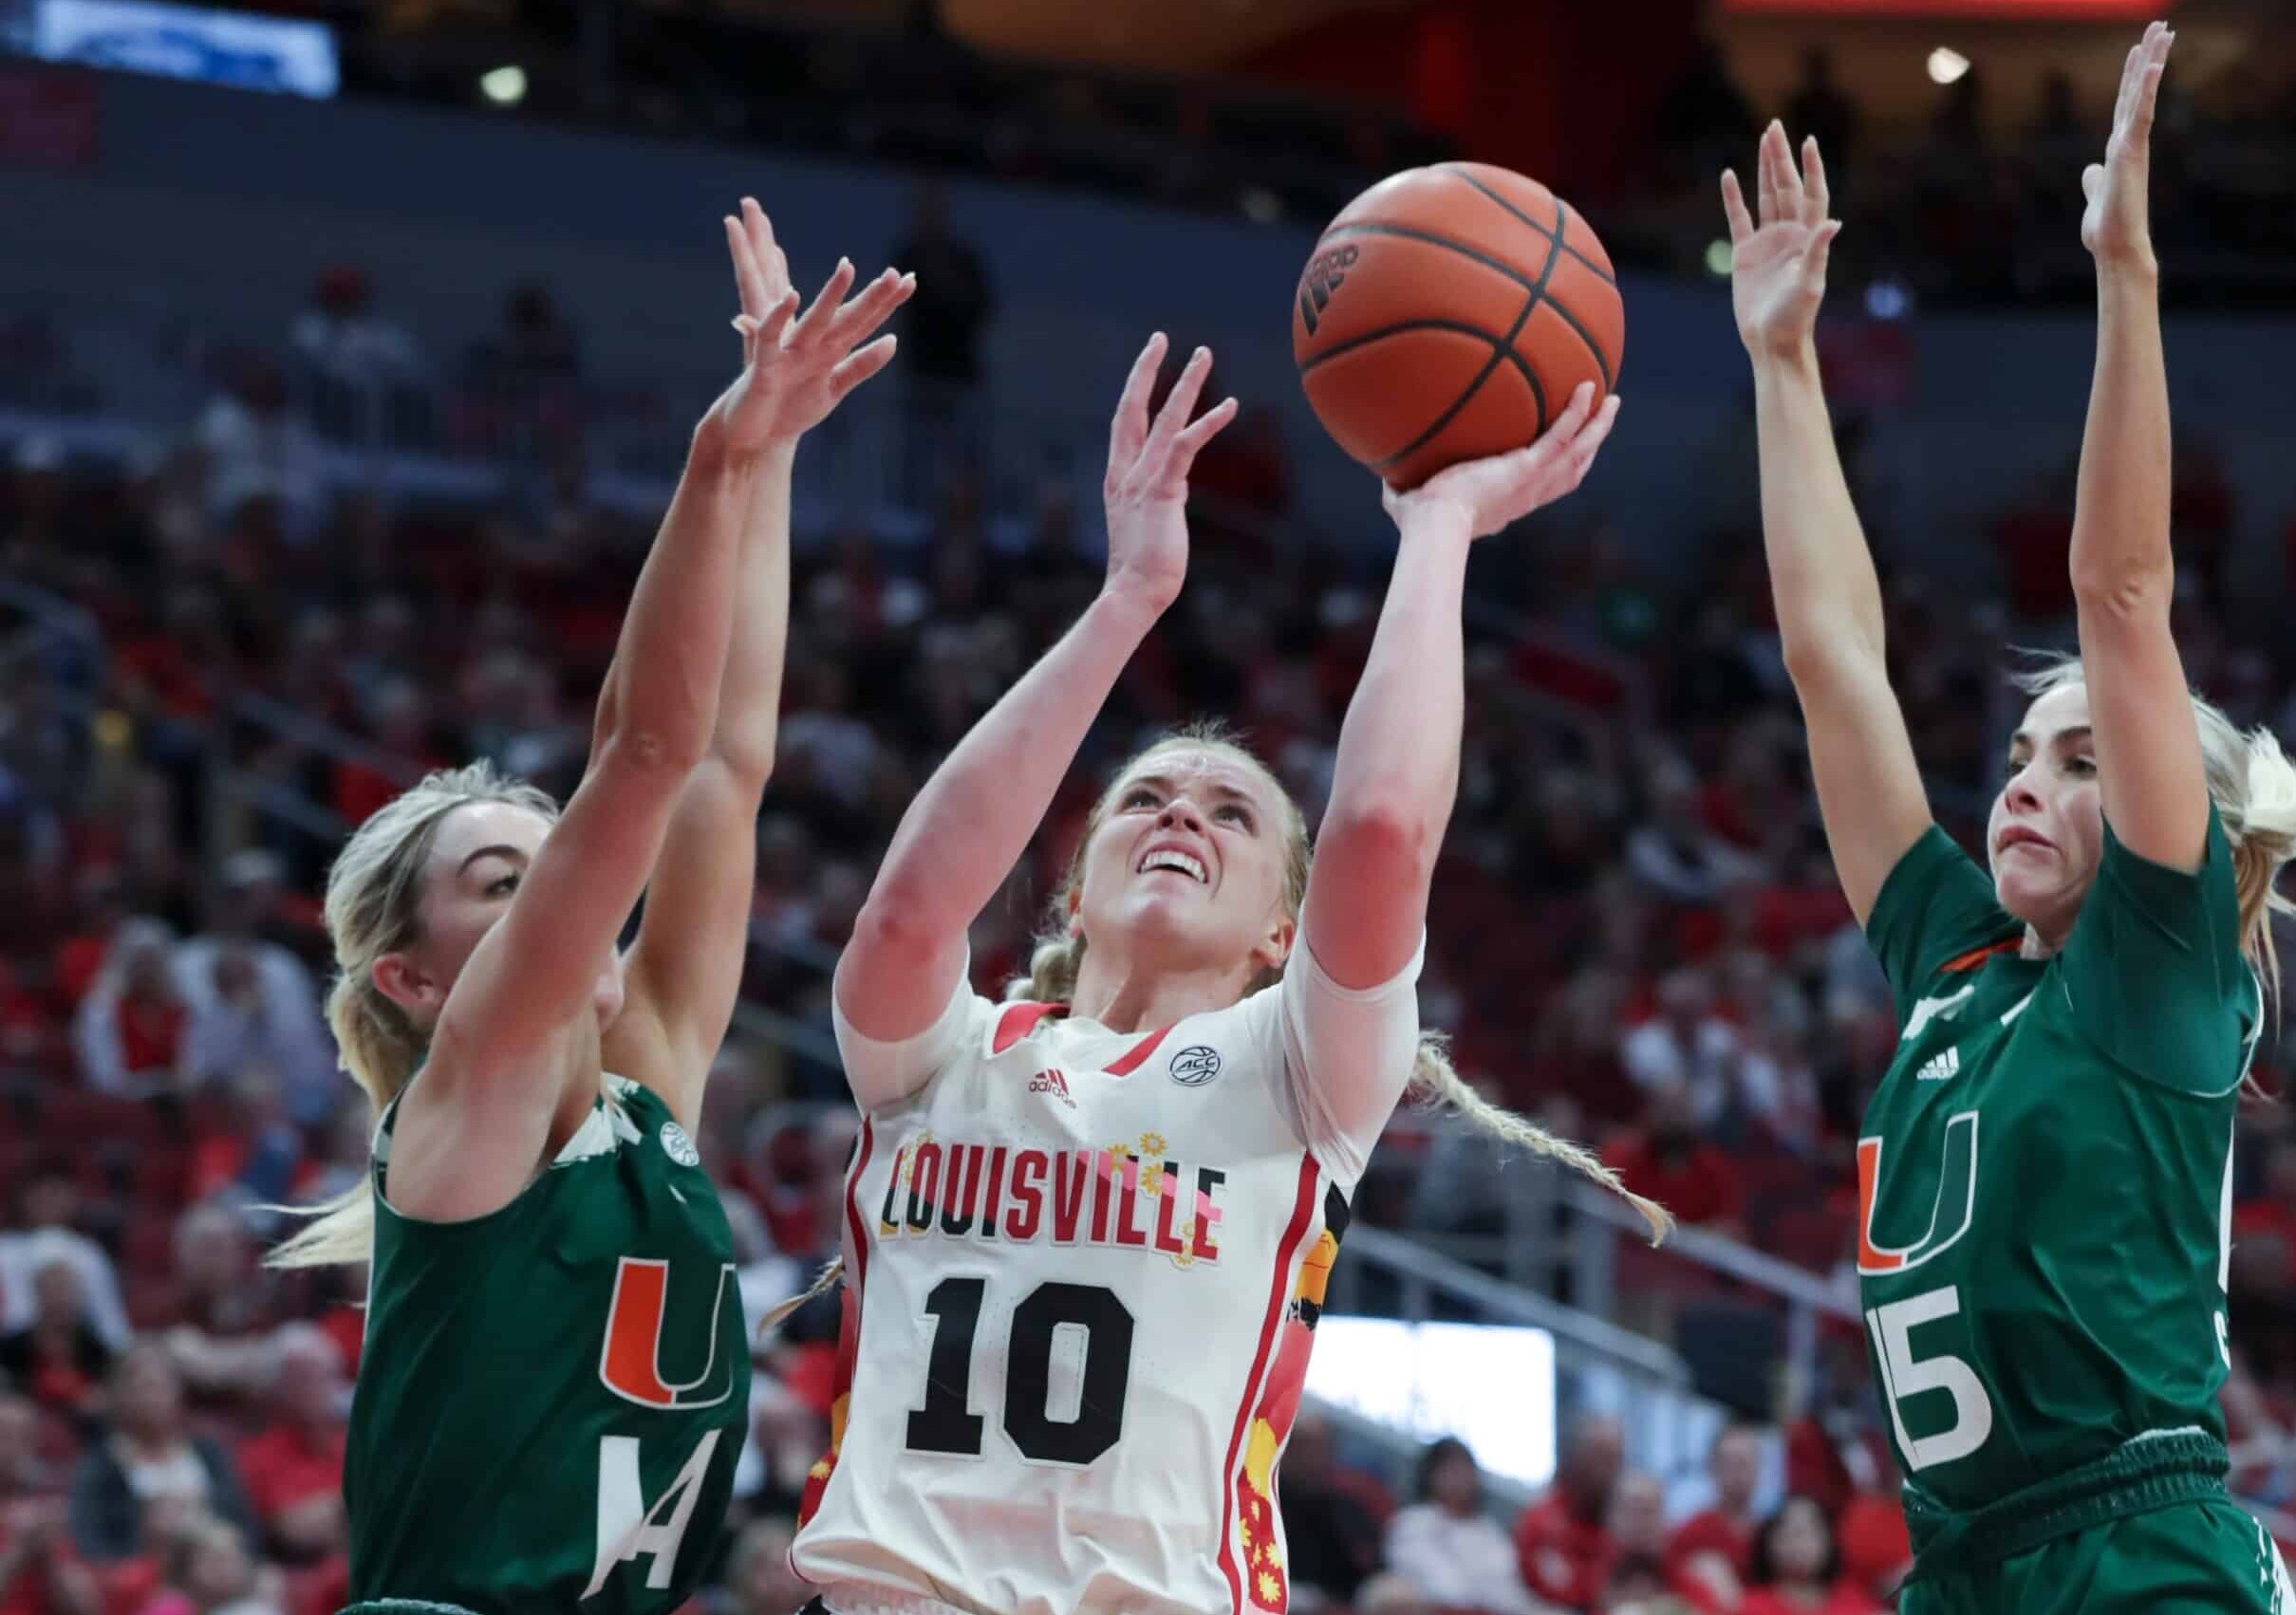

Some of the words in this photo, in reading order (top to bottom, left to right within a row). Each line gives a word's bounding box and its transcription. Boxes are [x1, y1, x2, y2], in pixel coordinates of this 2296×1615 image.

[1176, 1055, 1216, 1071] ACC
[879, 1140, 1227, 1263] LOUISVILLE
[599, 1255, 737, 1410] U
[905, 1275, 1137, 1467] 10
